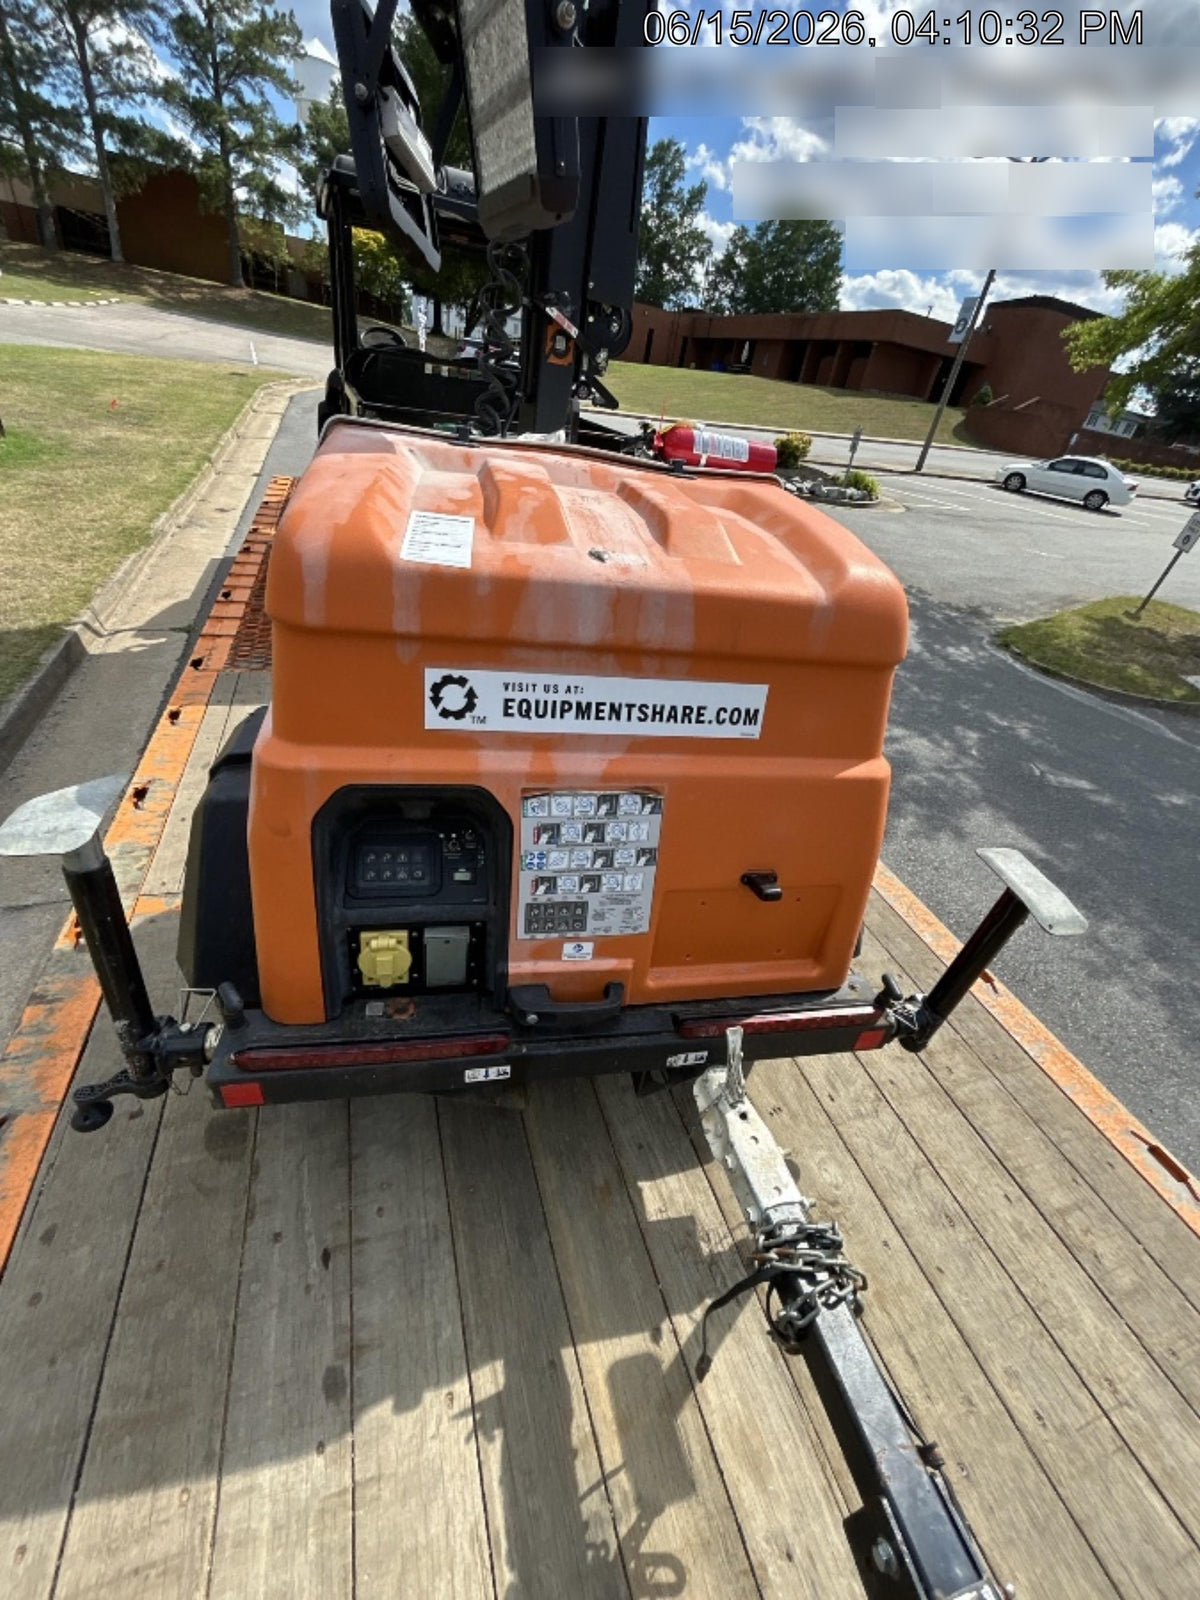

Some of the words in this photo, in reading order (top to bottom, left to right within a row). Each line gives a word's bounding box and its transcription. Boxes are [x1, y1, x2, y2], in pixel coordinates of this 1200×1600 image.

[503, 682, 538, 693] VISIT
[543, 684, 559, 694] US
[565, 685, 584, 694] AT:
[503, 699, 759, 726] EQUIPMENTSHARE.COM
[470, 716, 487, 725] TM
